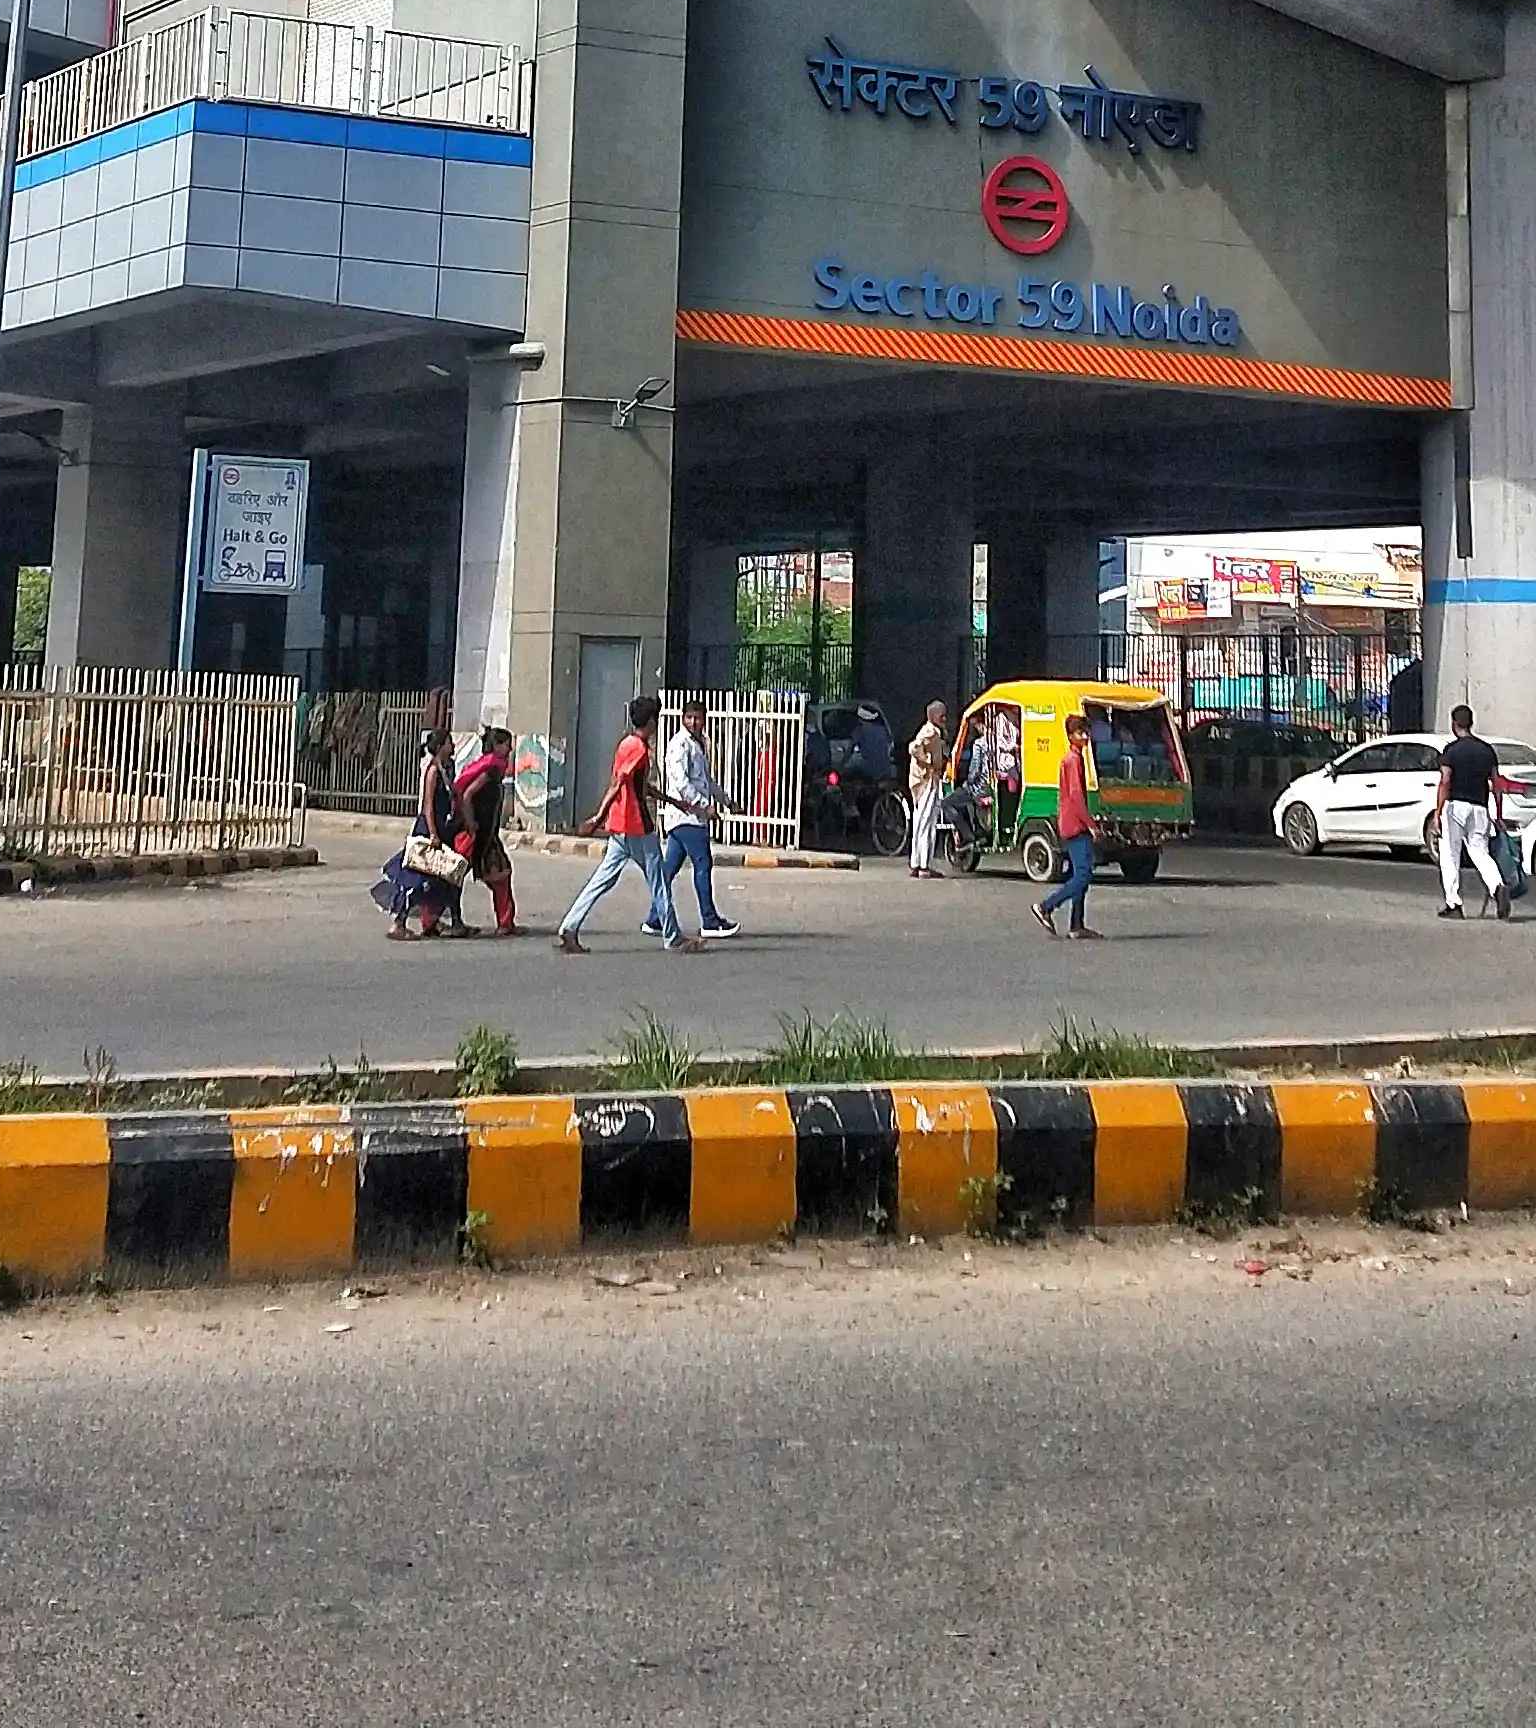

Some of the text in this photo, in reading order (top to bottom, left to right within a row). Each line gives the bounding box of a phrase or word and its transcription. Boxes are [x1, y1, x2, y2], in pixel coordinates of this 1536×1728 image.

[806, 33, 1203, 154] सेक्टर 59 नोएडा
[813, 255, 1242, 347] Sector 59 Noida
[223, 528, 288, 545] Halt & Go
